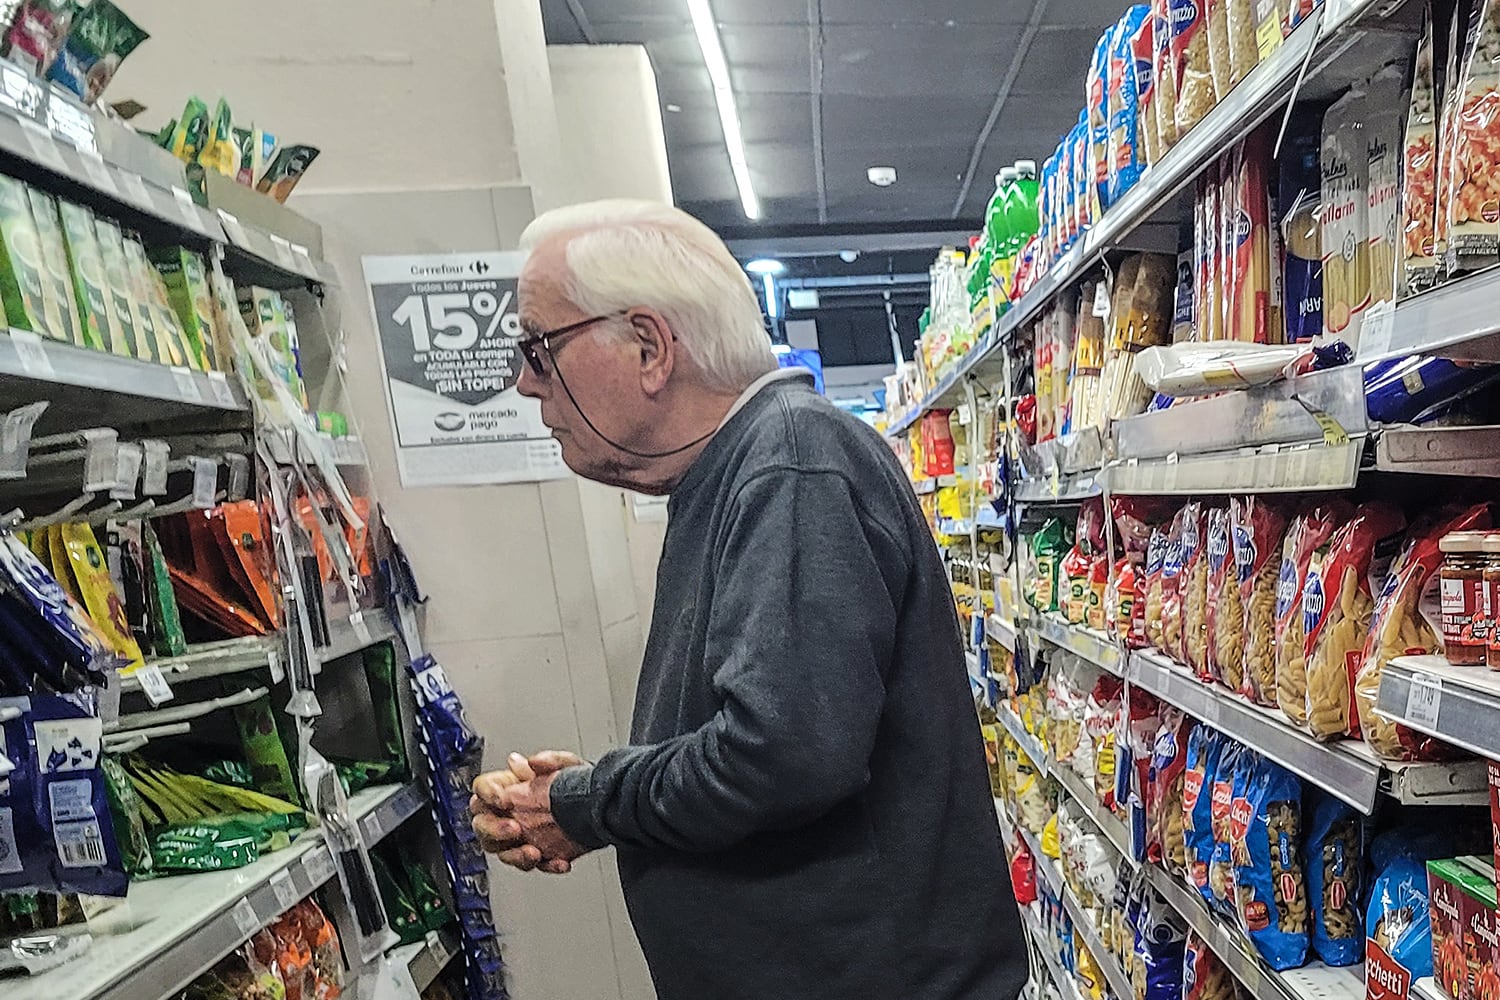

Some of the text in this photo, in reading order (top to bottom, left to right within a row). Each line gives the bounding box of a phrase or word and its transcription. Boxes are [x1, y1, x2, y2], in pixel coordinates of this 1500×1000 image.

[410, 265, 464, 276] Carrefour
[392, 291, 523, 351] 15%
[430, 351, 460, 361] TODA
[475, 349, 515, 360] compra
[426, 360, 508, 371] ACUMULABLE CON
[424, 371, 455, 380] TODAS
[474, 368, 513, 377] PROMOS
[468, 408, 517, 419] mercado
[470, 419, 498, 430] pago
